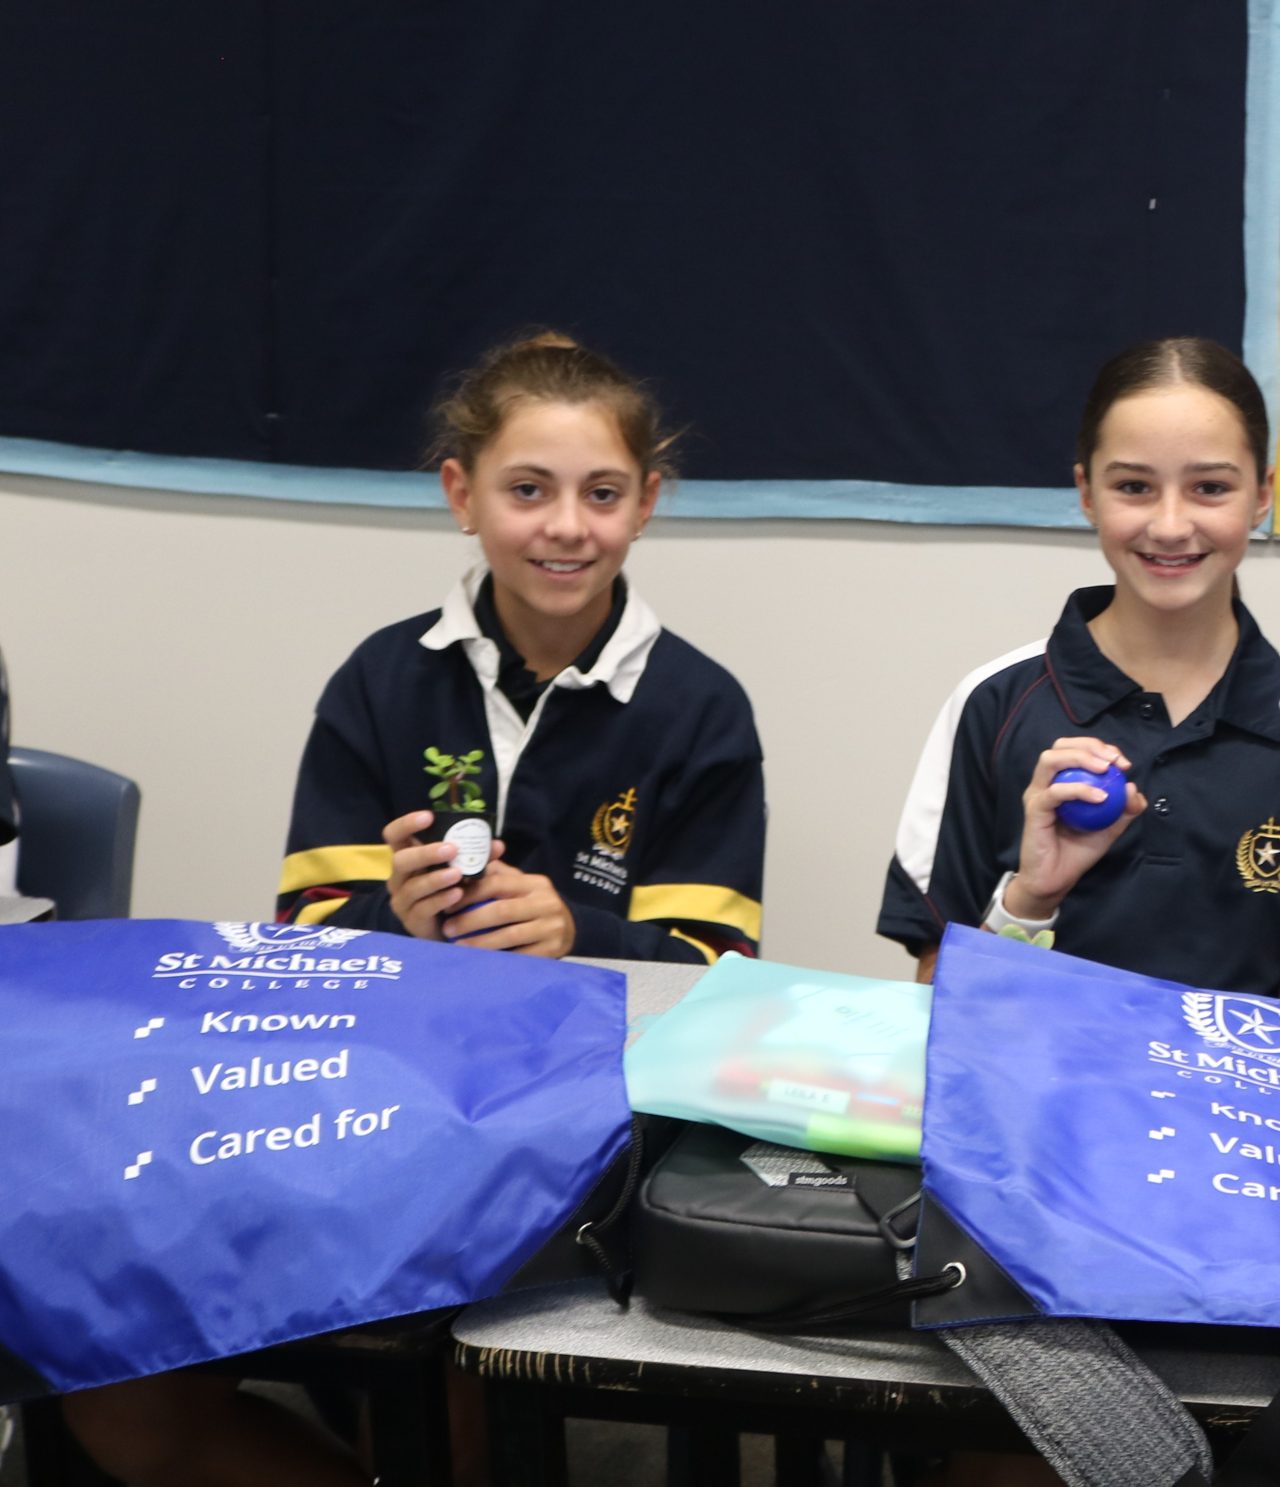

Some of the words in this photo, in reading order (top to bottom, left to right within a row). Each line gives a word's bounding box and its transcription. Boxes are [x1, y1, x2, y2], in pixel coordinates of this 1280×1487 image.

[154, 952, 204, 972] St
[208, 953, 403, 974] Michael's
[178, 977, 369, 991] COLLEGE
[200, 1010, 356, 1034] Known
[1148, 1040, 1190, 1064] St
[190, 1048, 349, 1095] Valued
[189, 1112, 321, 1166] Cared
[334, 1104, 400, 1140] for
